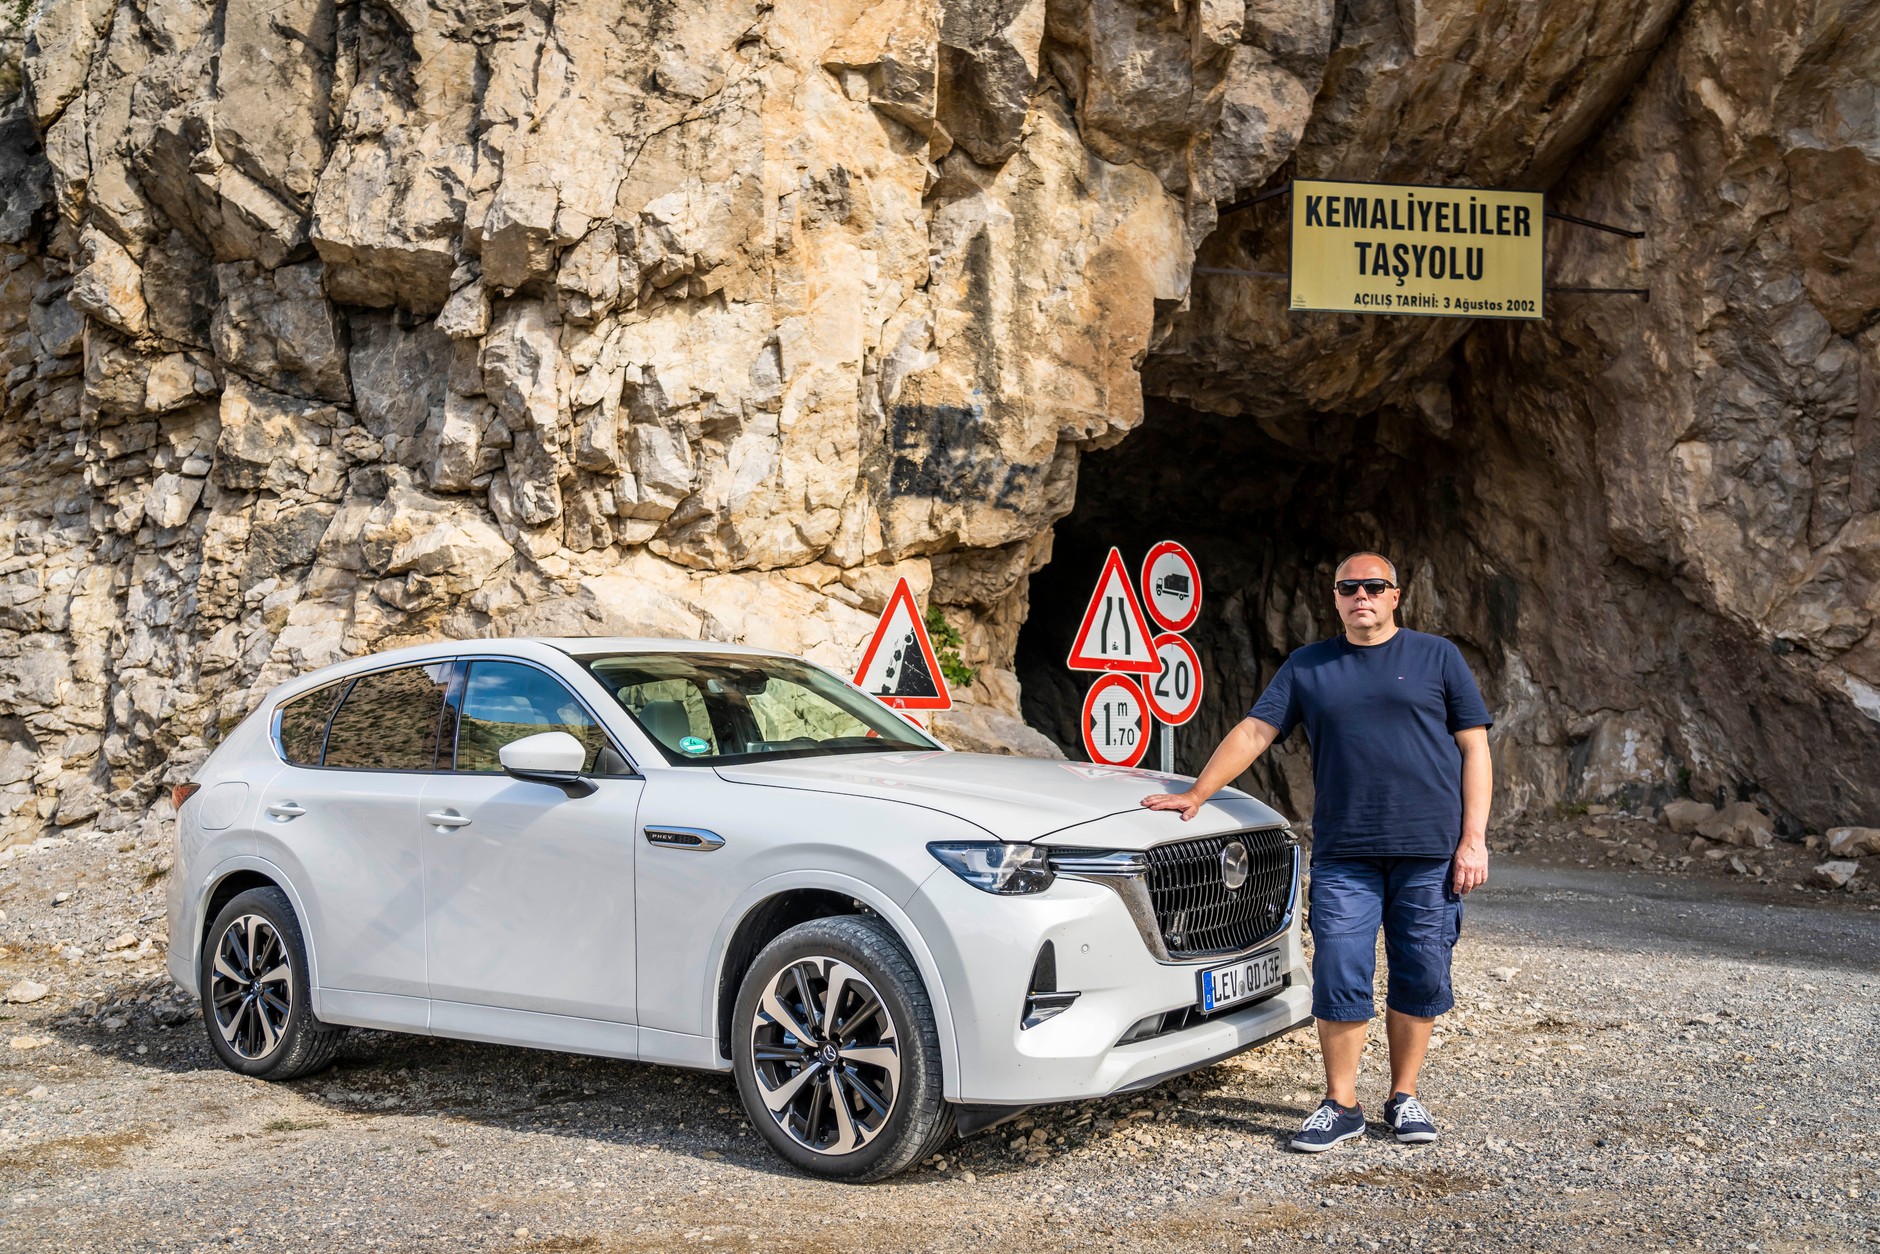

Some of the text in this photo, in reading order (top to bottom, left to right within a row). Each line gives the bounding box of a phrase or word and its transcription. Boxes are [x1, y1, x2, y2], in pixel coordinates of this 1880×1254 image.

[1306, 192, 1531, 237] KEMALİYELİLER
[1354, 241, 1484, 287] TAŞYOLU
[1354, 292, 1535, 313] AÇILIŞ TARİHİ: 3 Ağustos 2002
[1154, 656, 1189, 701] 20
[1213, 970, 1238, 1003] LEV
